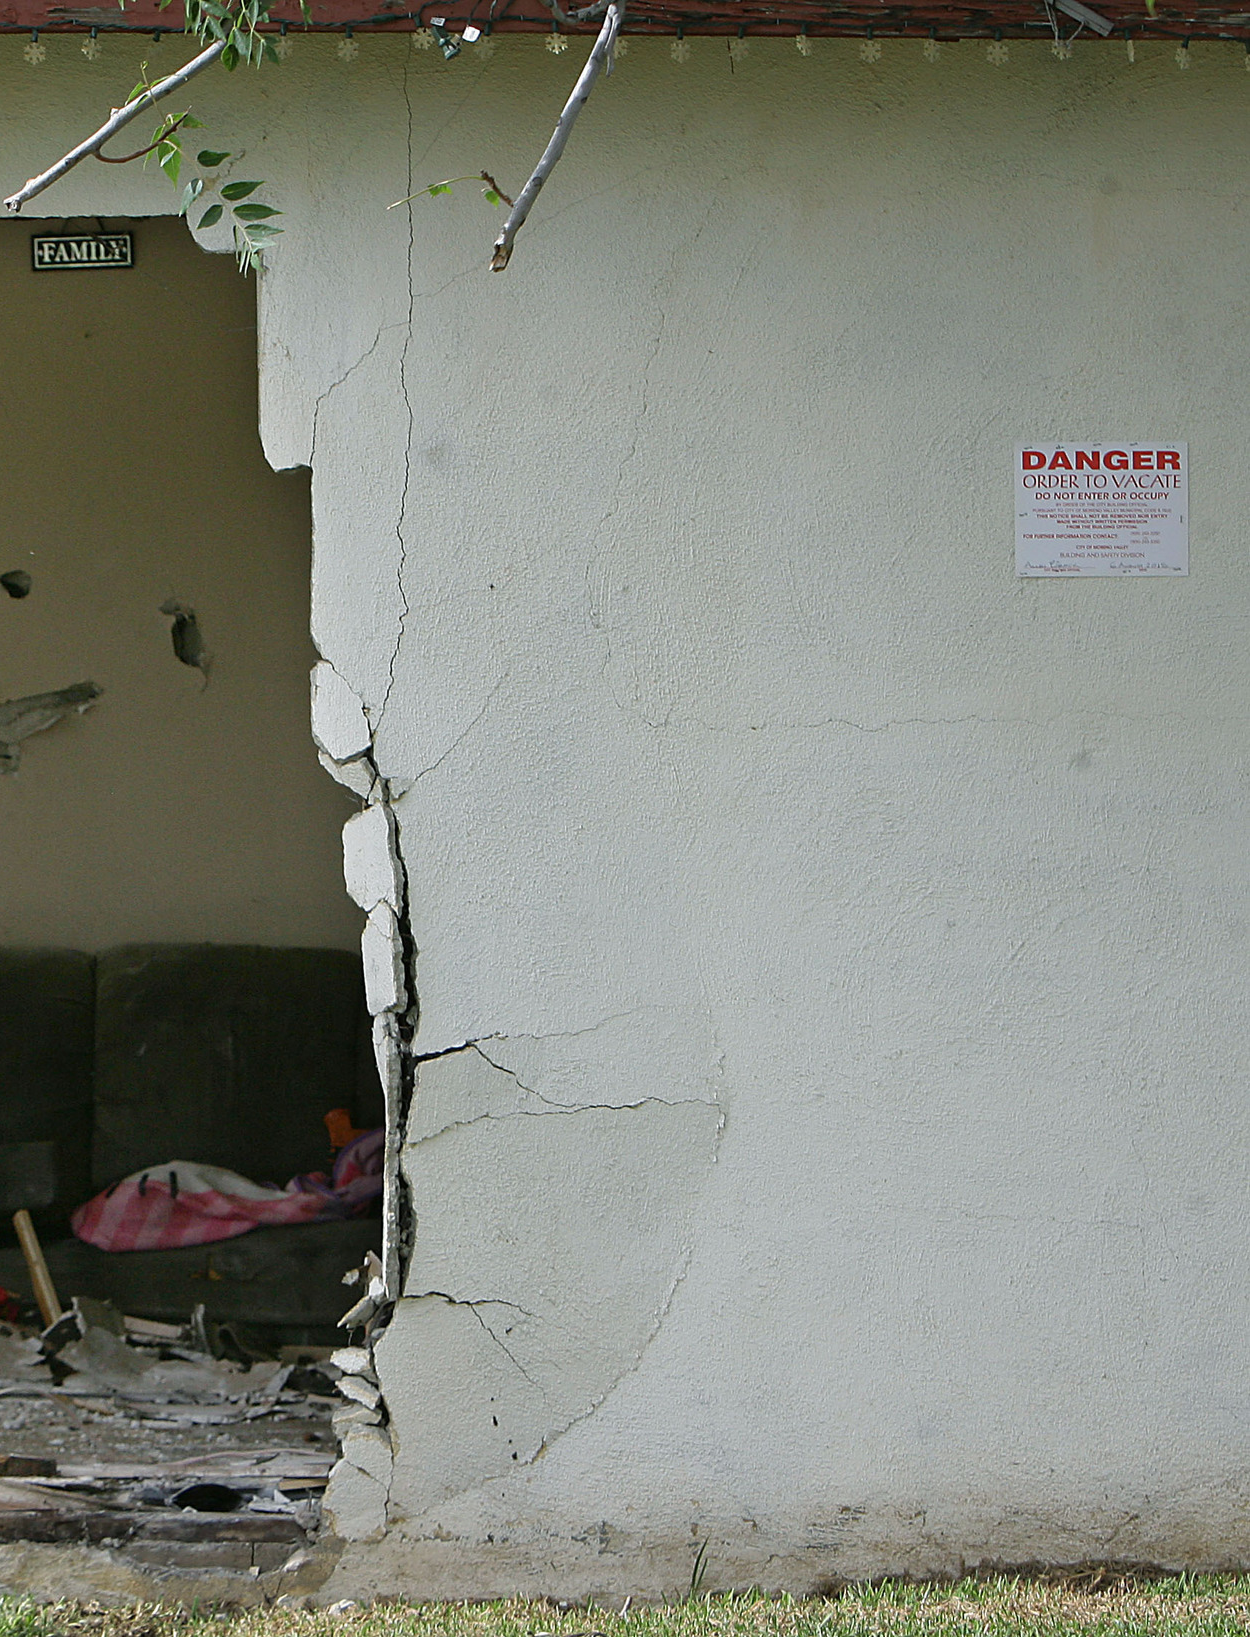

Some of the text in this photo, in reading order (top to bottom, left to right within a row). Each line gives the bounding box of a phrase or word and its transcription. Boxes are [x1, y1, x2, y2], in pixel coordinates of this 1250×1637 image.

[42, 240, 124, 262] FAMILY
[1022, 450, 1181, 470] DANGER
[1023, 474, 1181, 488] ORDER TO VACATE
[1035, 492, 1169, 500] DO NOT ENTER OR OCCUPY
